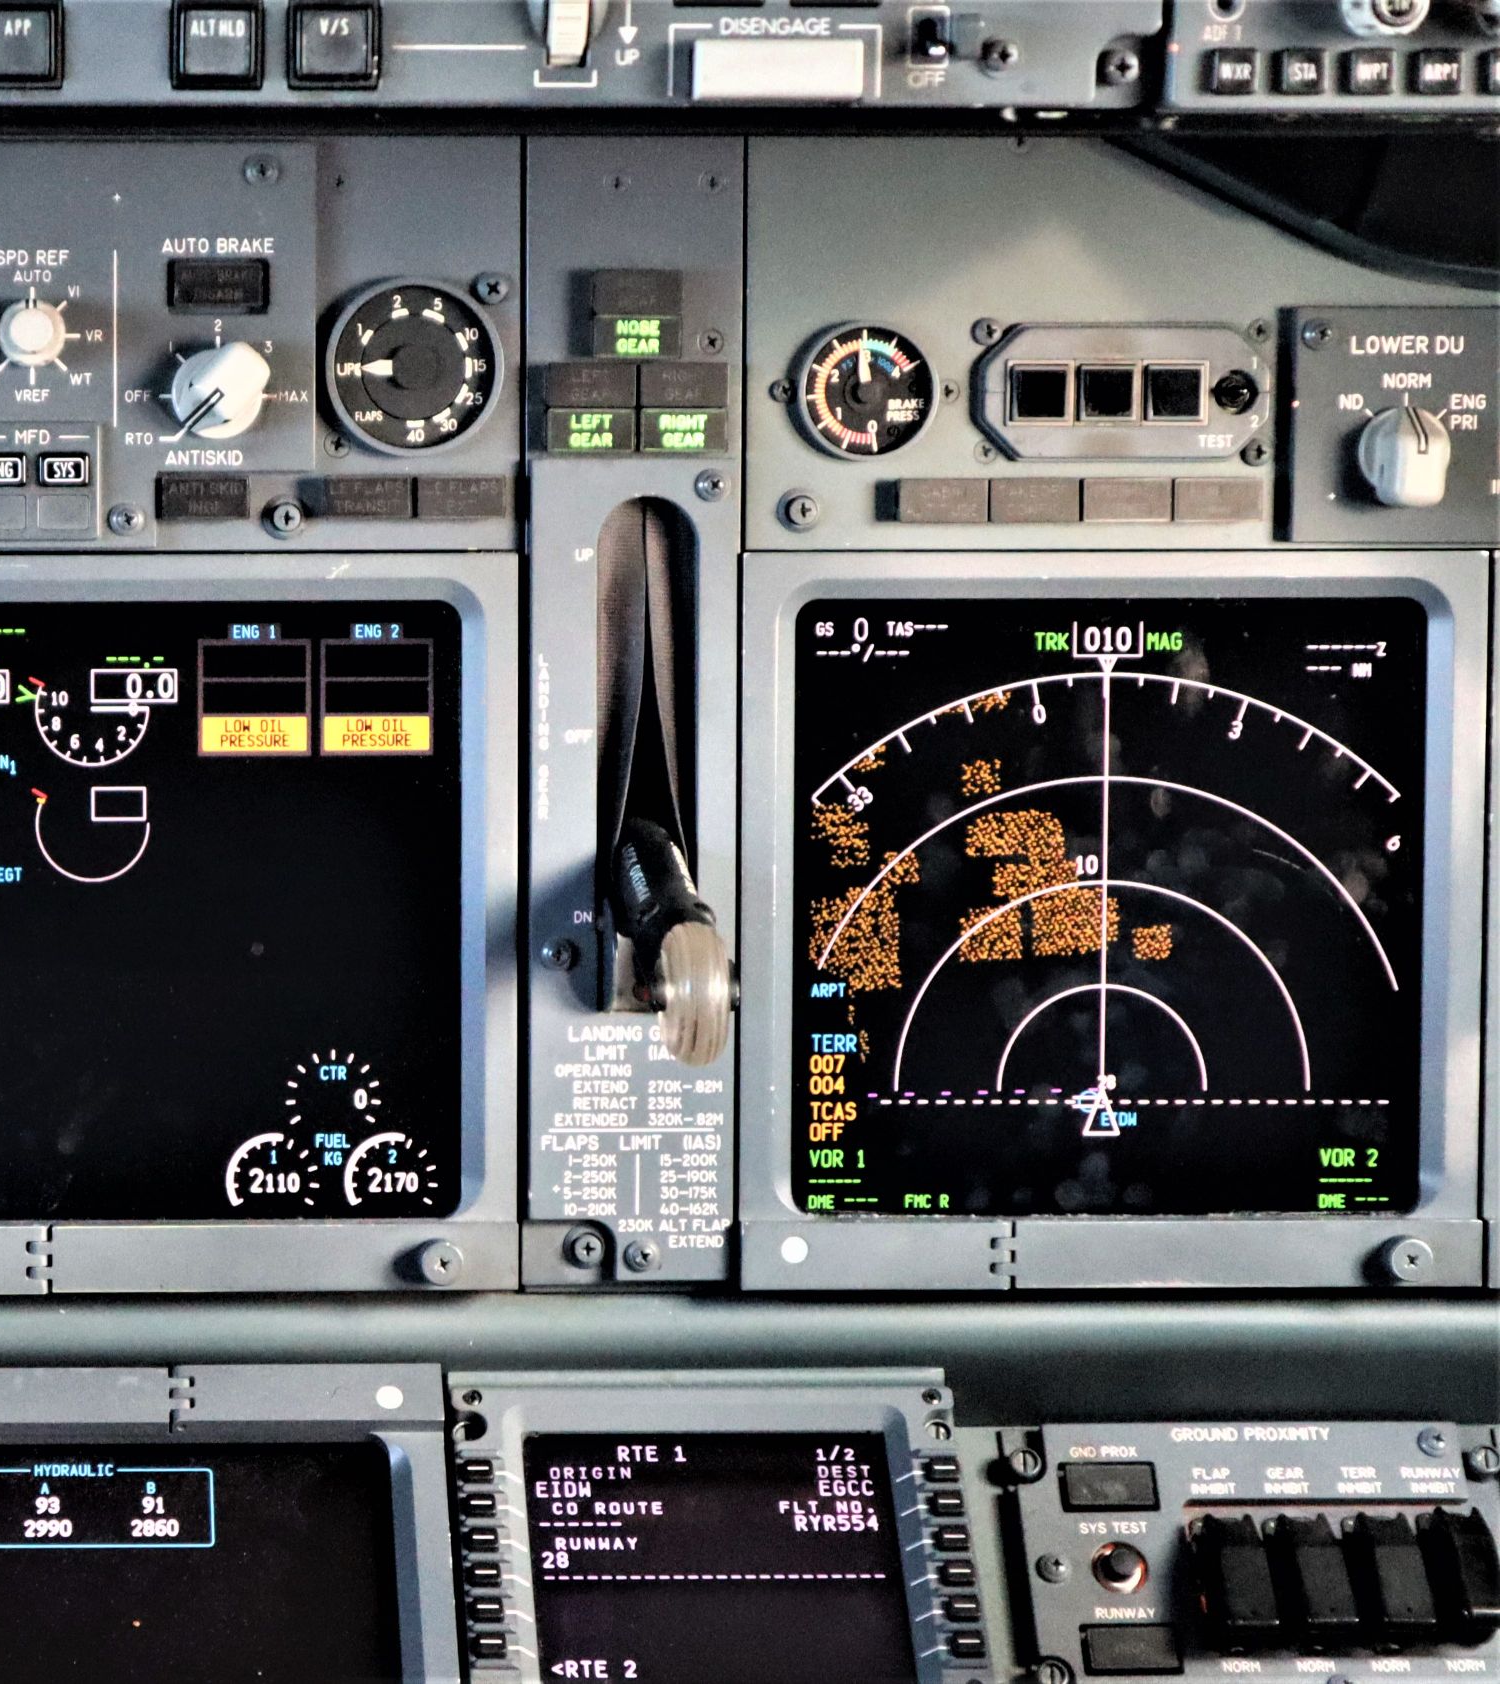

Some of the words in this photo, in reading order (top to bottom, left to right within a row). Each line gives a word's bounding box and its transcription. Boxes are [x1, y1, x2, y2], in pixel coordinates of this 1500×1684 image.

[4, 20, 31, 36] APP
[190, 20, 216, 37] ALT
[219, 20, 246, 37] HLD
[719, 18, 831, 36] DISENGAGE
[616, 50, 639, 67] UP
[1292, 63, 1317, 80] STA
[161, 238, 209, 253] AUTO
[217, 238, 274, 253] BRAKE
[36, 250, 69, 265] REF
[14, 270, 52, 282] AUTO
[616, 319, 660, 336] NOSE
[616, 338, 660, 354] GEAR
[1350, 335, 1429, 355] LOWER
[1435, 336, 1464, 354] DU
[1383, 373, 1432, 389] NORM
[15, 389, 50, 402] VREF
[1339, 394, 1364, 410] ND
[1451, 394, 1487, 410] ENG
[570, 413, 613, 430] LEFT
[659, 413, 708, 431] RIGHT
[15, 430, 50, 445] MFD
[125, 432, 153, 446] RTO
[569, 432, 613, 448] GEAR
[662, 432, 705, 448] GEAR
[165, 450, 243, 466] ANTISKID
[1034, 631, 1070, 651] TRK
[1084, 626, 1132, 652] 010
[1146, 632, 1183, 651] MAG
[224, 720, 250, 733] LOW
[260, 720, 285, 733] OIL
[346, 719, 372, 732] LOW
[382, 719, 407, 732] OIL
[220, 734, 290, 748] PRESSURE
[342, 733, 412, 747] PRESSURE
[564, 730, 594, 744] OFF
[1075, 854, 1099, 875] 10
[574, 910, 593, 923] DN
[811, 982, 846, 998] ARPT
[568, 1025, 642, 1042] LANDING
[811, 1033, 857, 1053] TERR
[554, 1064, 632, 1078] OPERATING
[810, 1054, 845, 1074] 007
[319, 1065, 347, 1081] CTR
[573, 1081, 628, 1094] EXTEND
[810, 1075, 845, 1095] 004
[573, 1097, 637, 1110] RETRACT
[647, 1097, 682, 1109] 235K
[810, 1101, 857, 1121] TCAS
[809, 1122, 845, 1141] OFF
[315, 1133, 350, 1148] FUEL
[541, 1135, 599, 1151] FLAPS
[619, 1135, 662, 1151] LIMIT
[682, 1134, 722, 1151] (IAS)
[1319, 1148, 1355, 1168] VOR
[1366, 1148, 1378, 1168] 2
[248, 1167, 300, 1194] 2110
[367, 1166, 419, 1193] 2170
[1318, 1193, 1346, 1209] DME
[668, 1235, 724, 1249] EXTEND
[1170, 1427, 1238, 1443] GROUND
[1244, 1426, 1330, 1442] PROXIMITY
[34, 1464, 114, 1478] HYDRAULIC
[550, 1467, 632, 1480] ORIGIN
[817, 1465, 871, 1478] DEST
[1400, 1466, 1460, 1480] RUNWAY
[536, 1481, 591, 1499] EIDW
[818, 1480, 874, 1497] EGCC
[35, 1496, 60, 1514] 93
[142, 1496, 165, 1514] 91
[24, 1518, 73, 1538] 2990
[131, 1518, 180, 1537] 2860
[795, 1515, 879, 1532] RYR554
[555, 1537, 638, 1551] RUNWAY
[1095, 1608, 1156, 1619] RUNWAY
[1222, 1661, 1261, 1674] NORM
